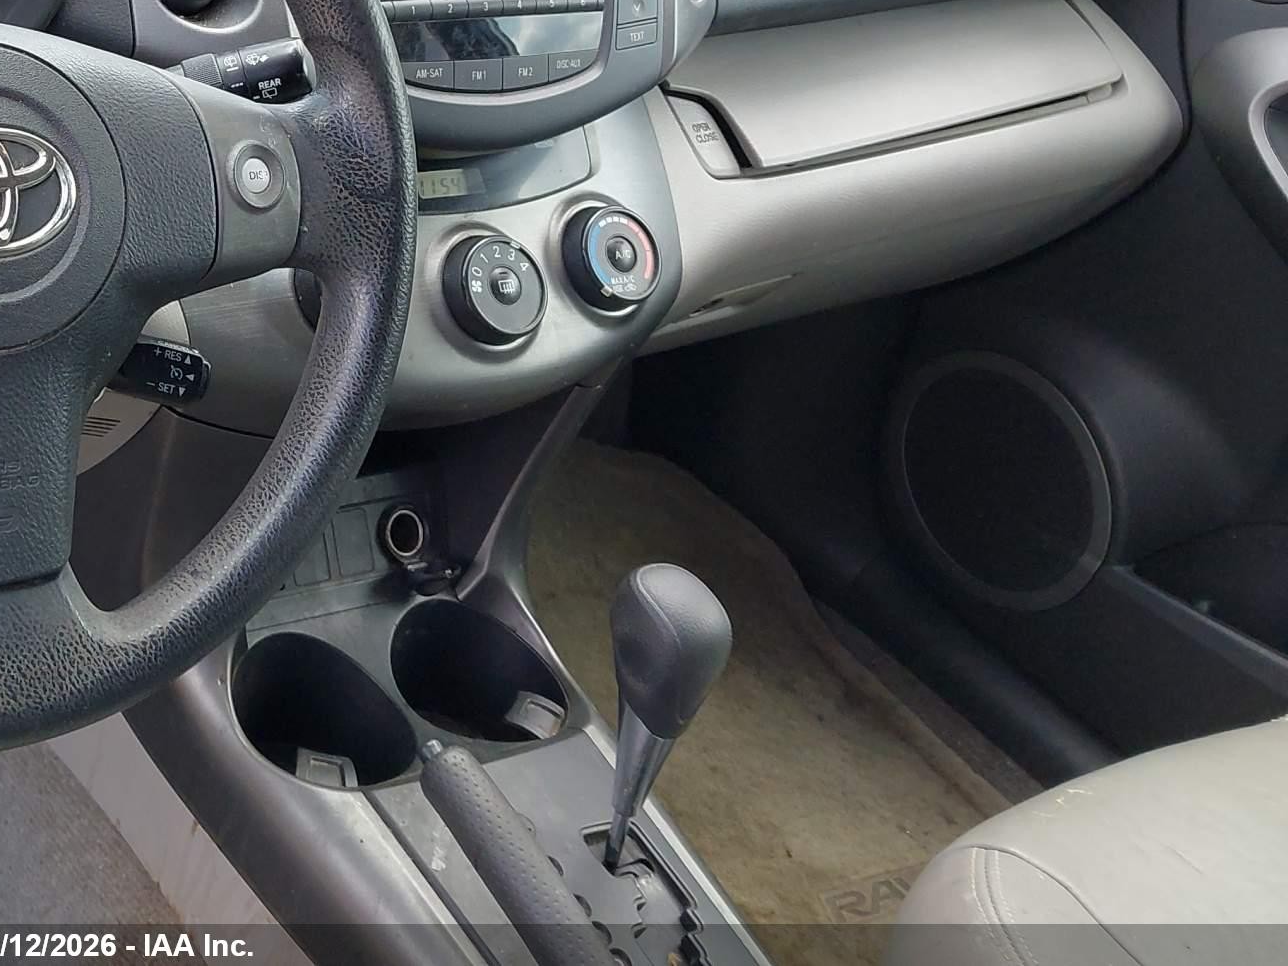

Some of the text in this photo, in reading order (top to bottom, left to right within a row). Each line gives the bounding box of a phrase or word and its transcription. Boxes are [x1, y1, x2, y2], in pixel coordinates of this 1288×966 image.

[447, 4, 454, 14] 2
[483, 1, 489, 11] 3
[516, 0, 523, 9] 4
[258, 78, 282, 90] REAR
[615, 249, 631, 260] A/C
[472, 245, 529, 277] 0 1 2 3 4
[164, 349, 182, 362] RES
[158, 382, 175, 394] SET
